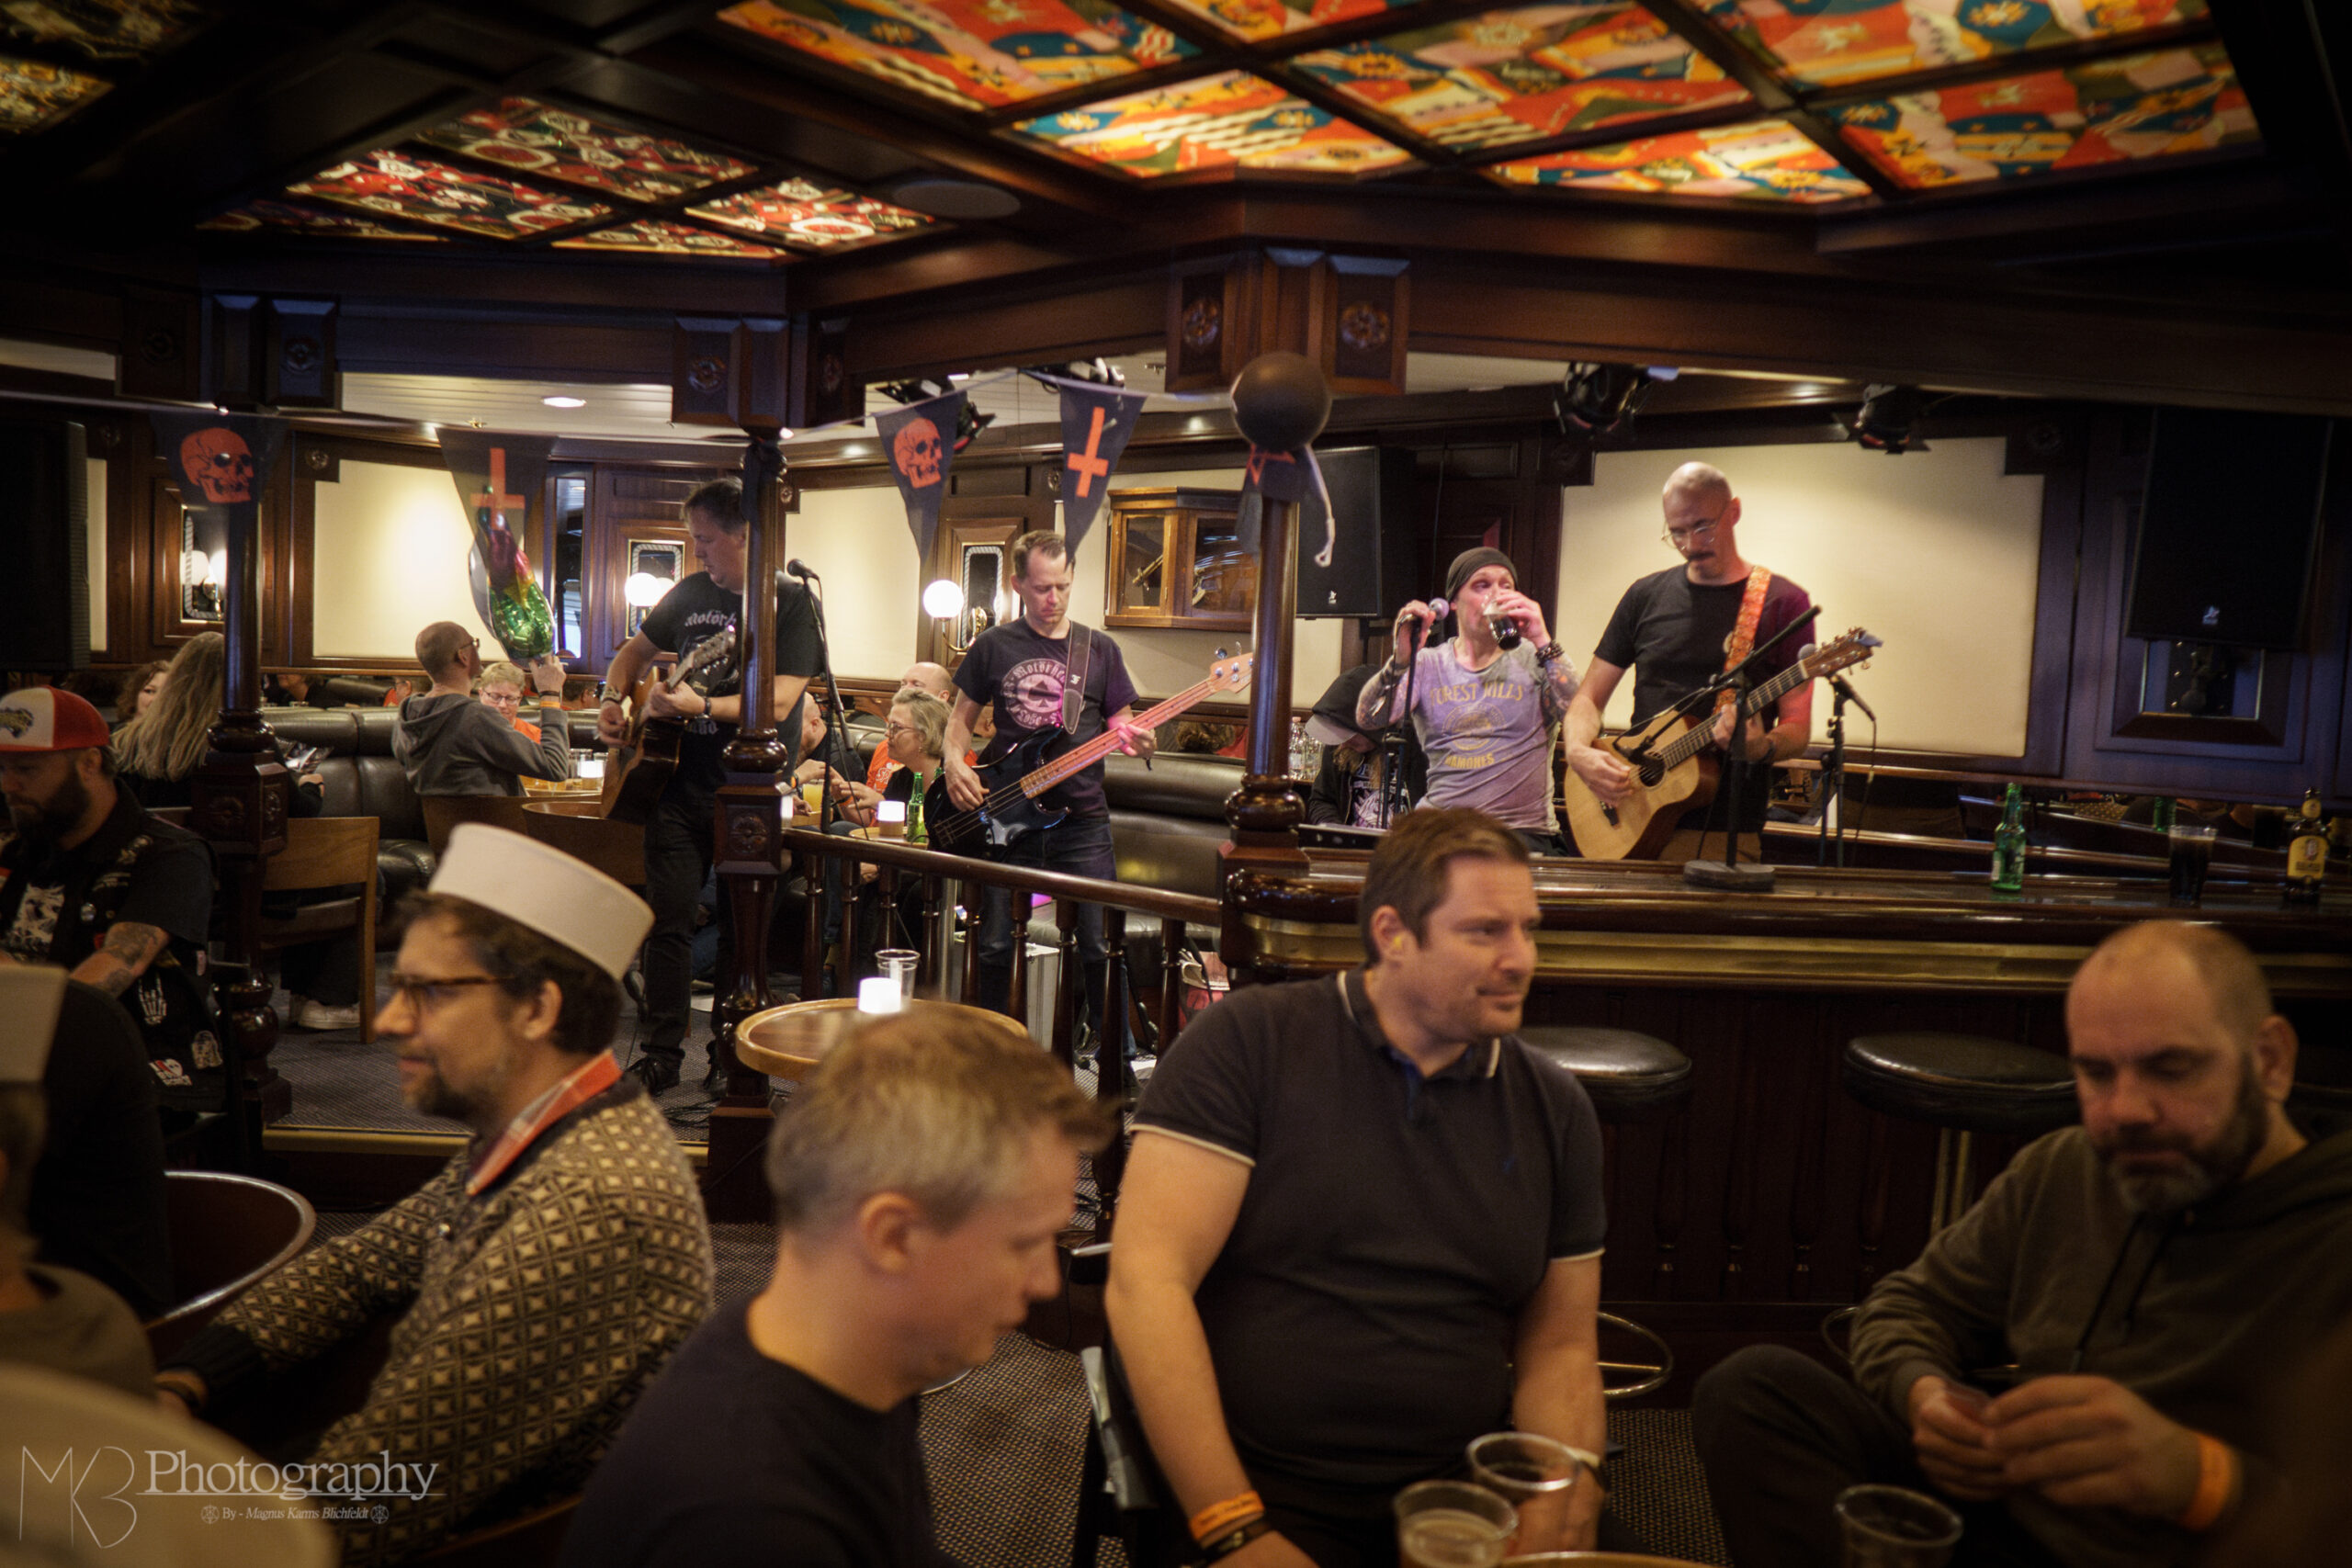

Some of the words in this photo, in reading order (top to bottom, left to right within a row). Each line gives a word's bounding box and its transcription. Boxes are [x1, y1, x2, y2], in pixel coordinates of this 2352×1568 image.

[685, 610, 737, 626] Motörh
[1430, 682, 1476, 705] FOREST
[1445, 753, 1495, 769] RAMONES
